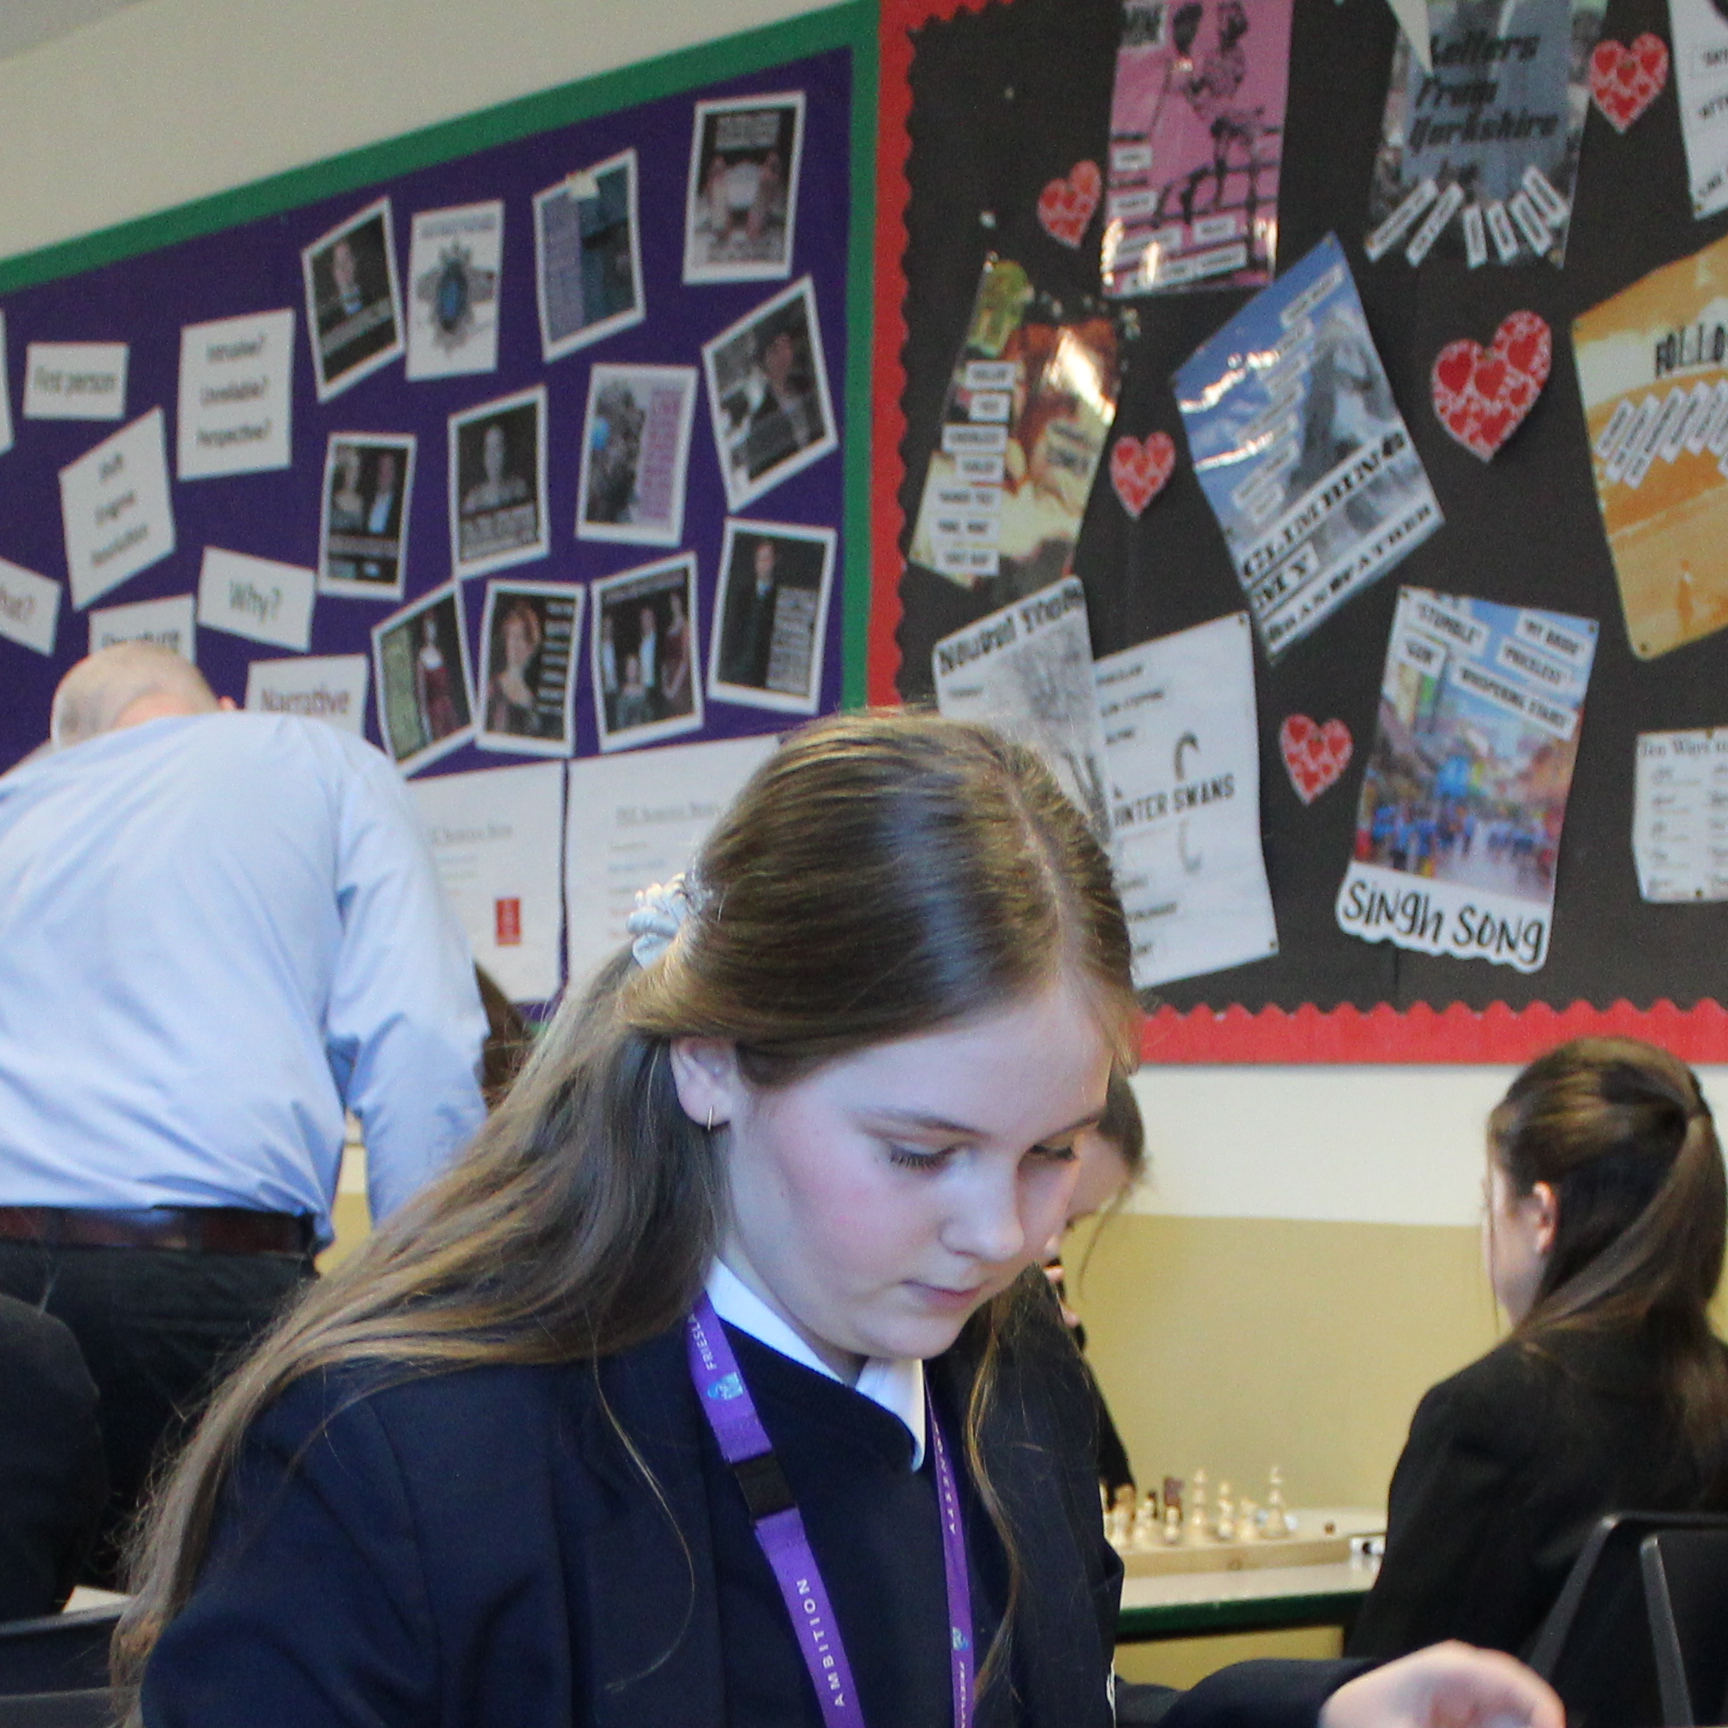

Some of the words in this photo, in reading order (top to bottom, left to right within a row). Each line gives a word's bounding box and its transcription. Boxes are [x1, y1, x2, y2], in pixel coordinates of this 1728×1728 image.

[1242, 432, 1404, 577] CLIMBING
[229, 583, 281, 622] Why?
[1254, 555, 1307, 608] MY
[259, 688, 350, 715] Narrative
[1113, 793, 1168, 830] INTER
[1175, 773, 1235, 812] SWANS
[686, 1312, 716, 1372] FRIESLA
[796, 1578, 846, 1708] AMBITION
